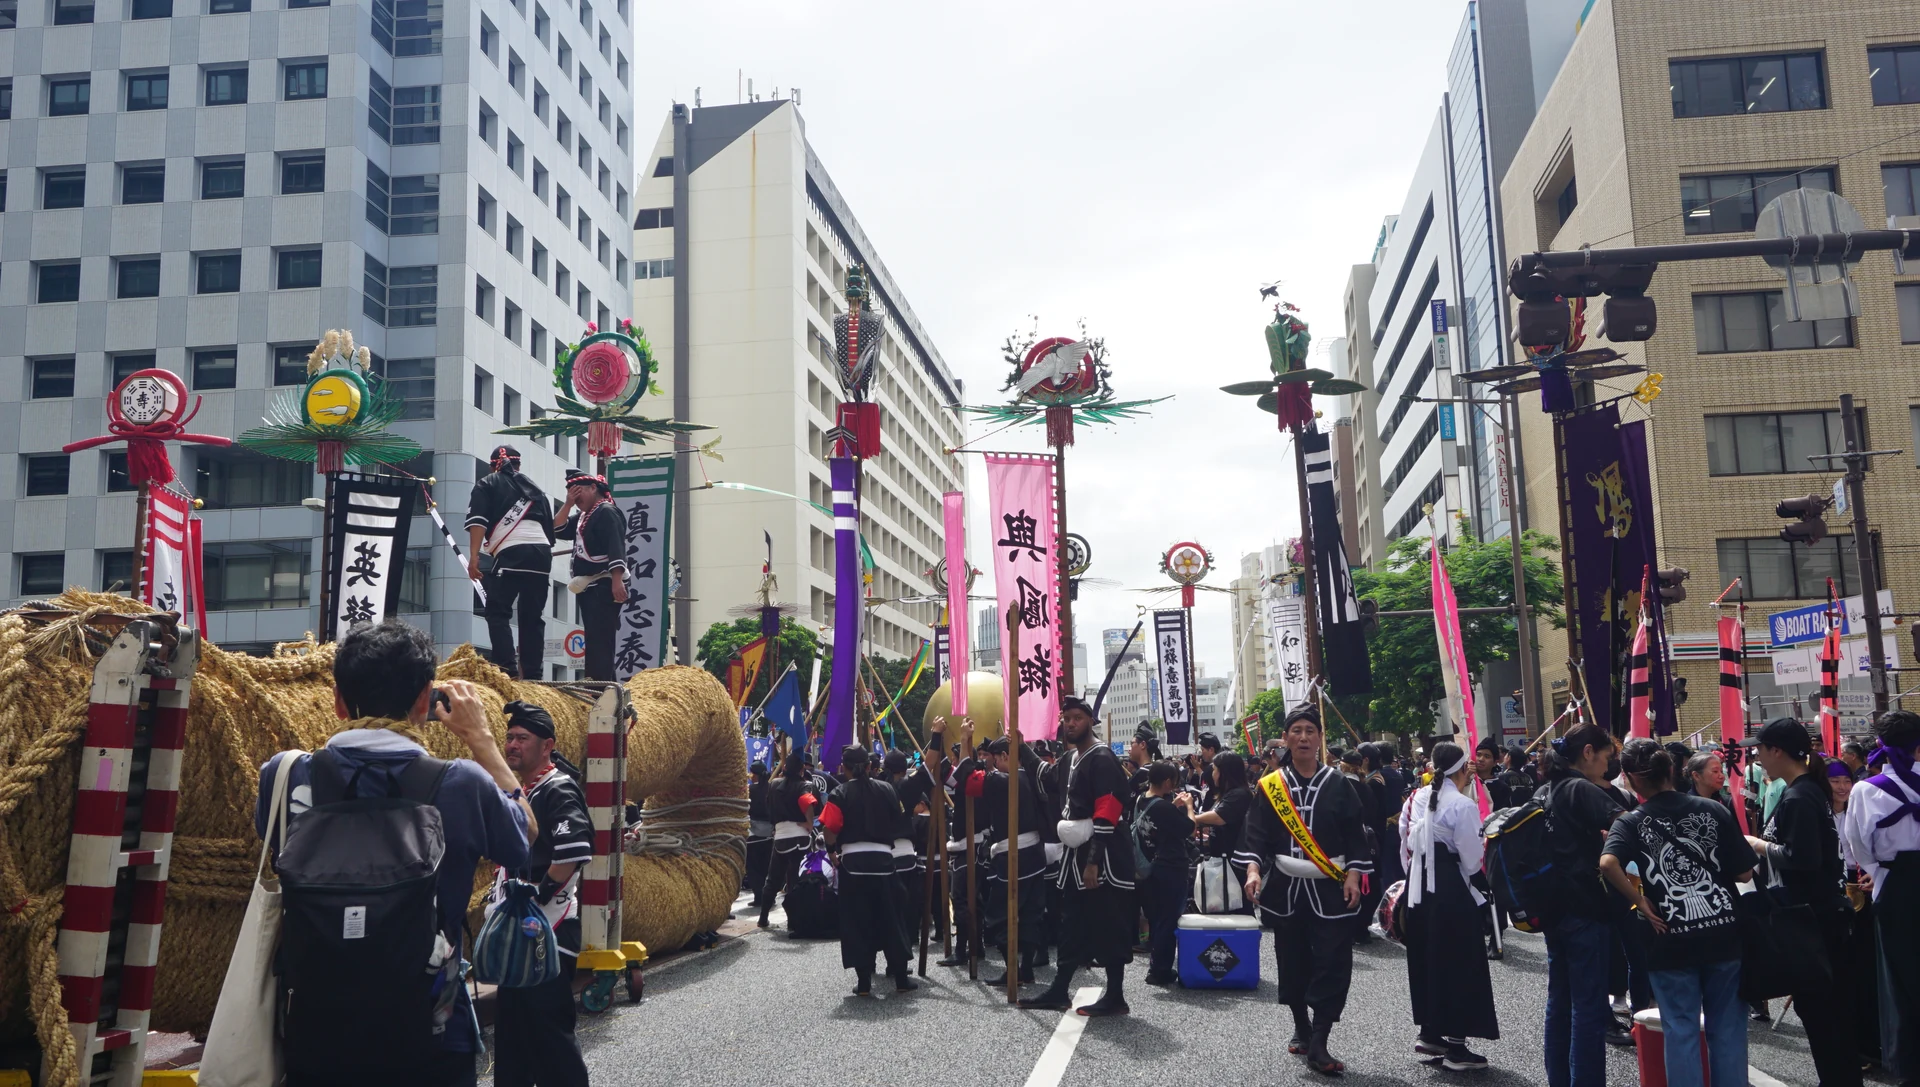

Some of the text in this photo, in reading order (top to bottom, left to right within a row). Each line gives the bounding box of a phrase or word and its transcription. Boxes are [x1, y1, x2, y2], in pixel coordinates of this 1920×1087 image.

[614, 501, 659, 682] 真和志泰
[1786, 613, 1811, 638] BOAT
[1812, 607, 1841, 633] RAE
[1723, 738, 1744, 778] 東
